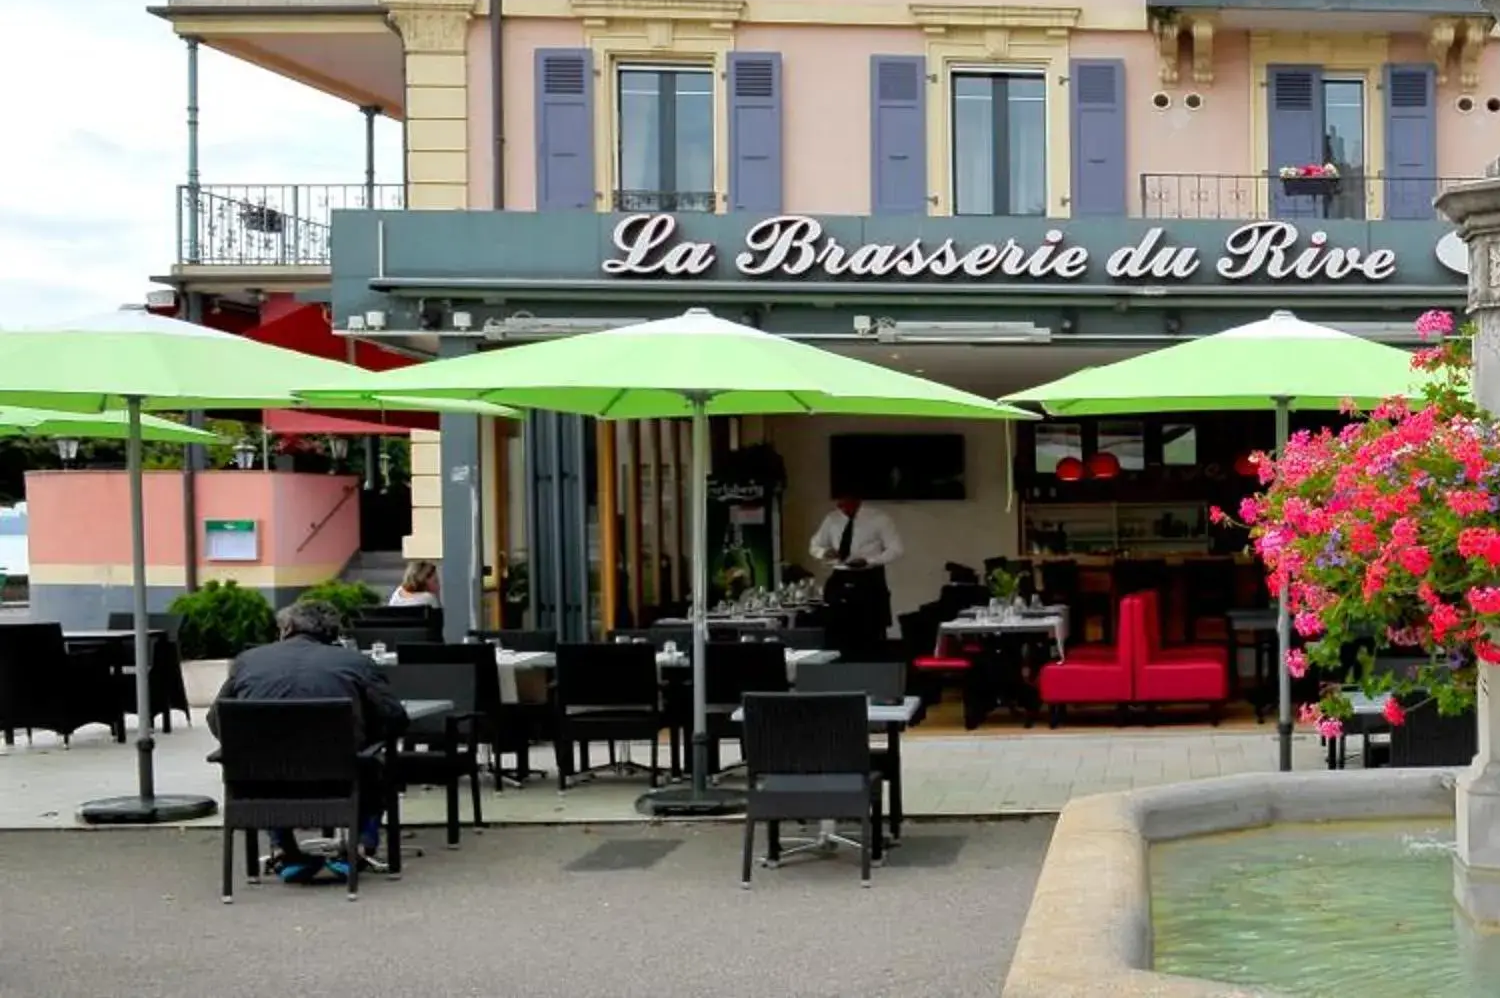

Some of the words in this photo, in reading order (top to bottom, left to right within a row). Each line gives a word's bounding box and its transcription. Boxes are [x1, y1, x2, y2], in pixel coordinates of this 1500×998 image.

[602, 213, 716, 275] La
[736, 215, 1088, 277] Brasserie
[1105, 228, 1201, 279] du
[1216, 221, 1397, 280] Rive
